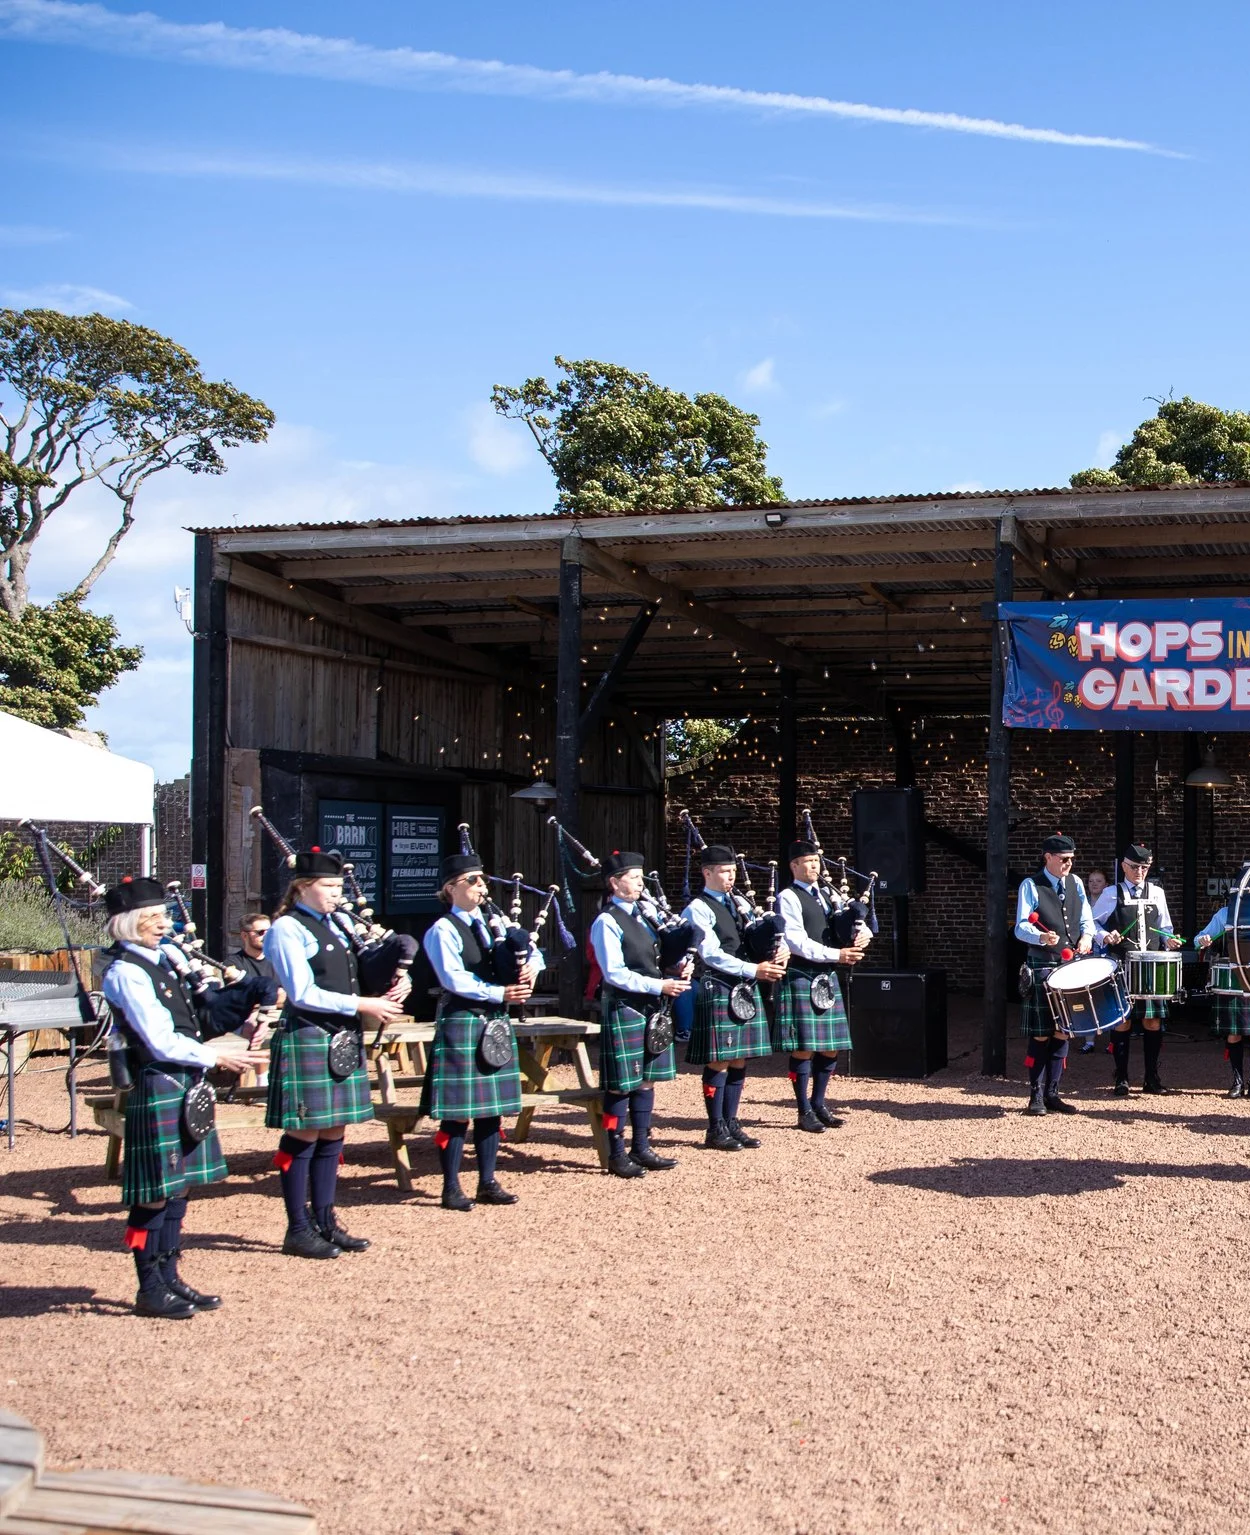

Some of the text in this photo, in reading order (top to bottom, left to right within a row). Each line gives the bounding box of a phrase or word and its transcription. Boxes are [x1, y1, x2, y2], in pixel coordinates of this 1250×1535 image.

[1076, 620, 1224, 662] HOPS
[1228, 630, 1250, 658] IN
[337, 825, 365, 845] BARN
[392, 822, 416, 836] HIRE
[410, 842, 432, 850] EVENT
[355, 863, 376, 878] AYS
[392, 868, 439, 877] BY EMAILING US AT
